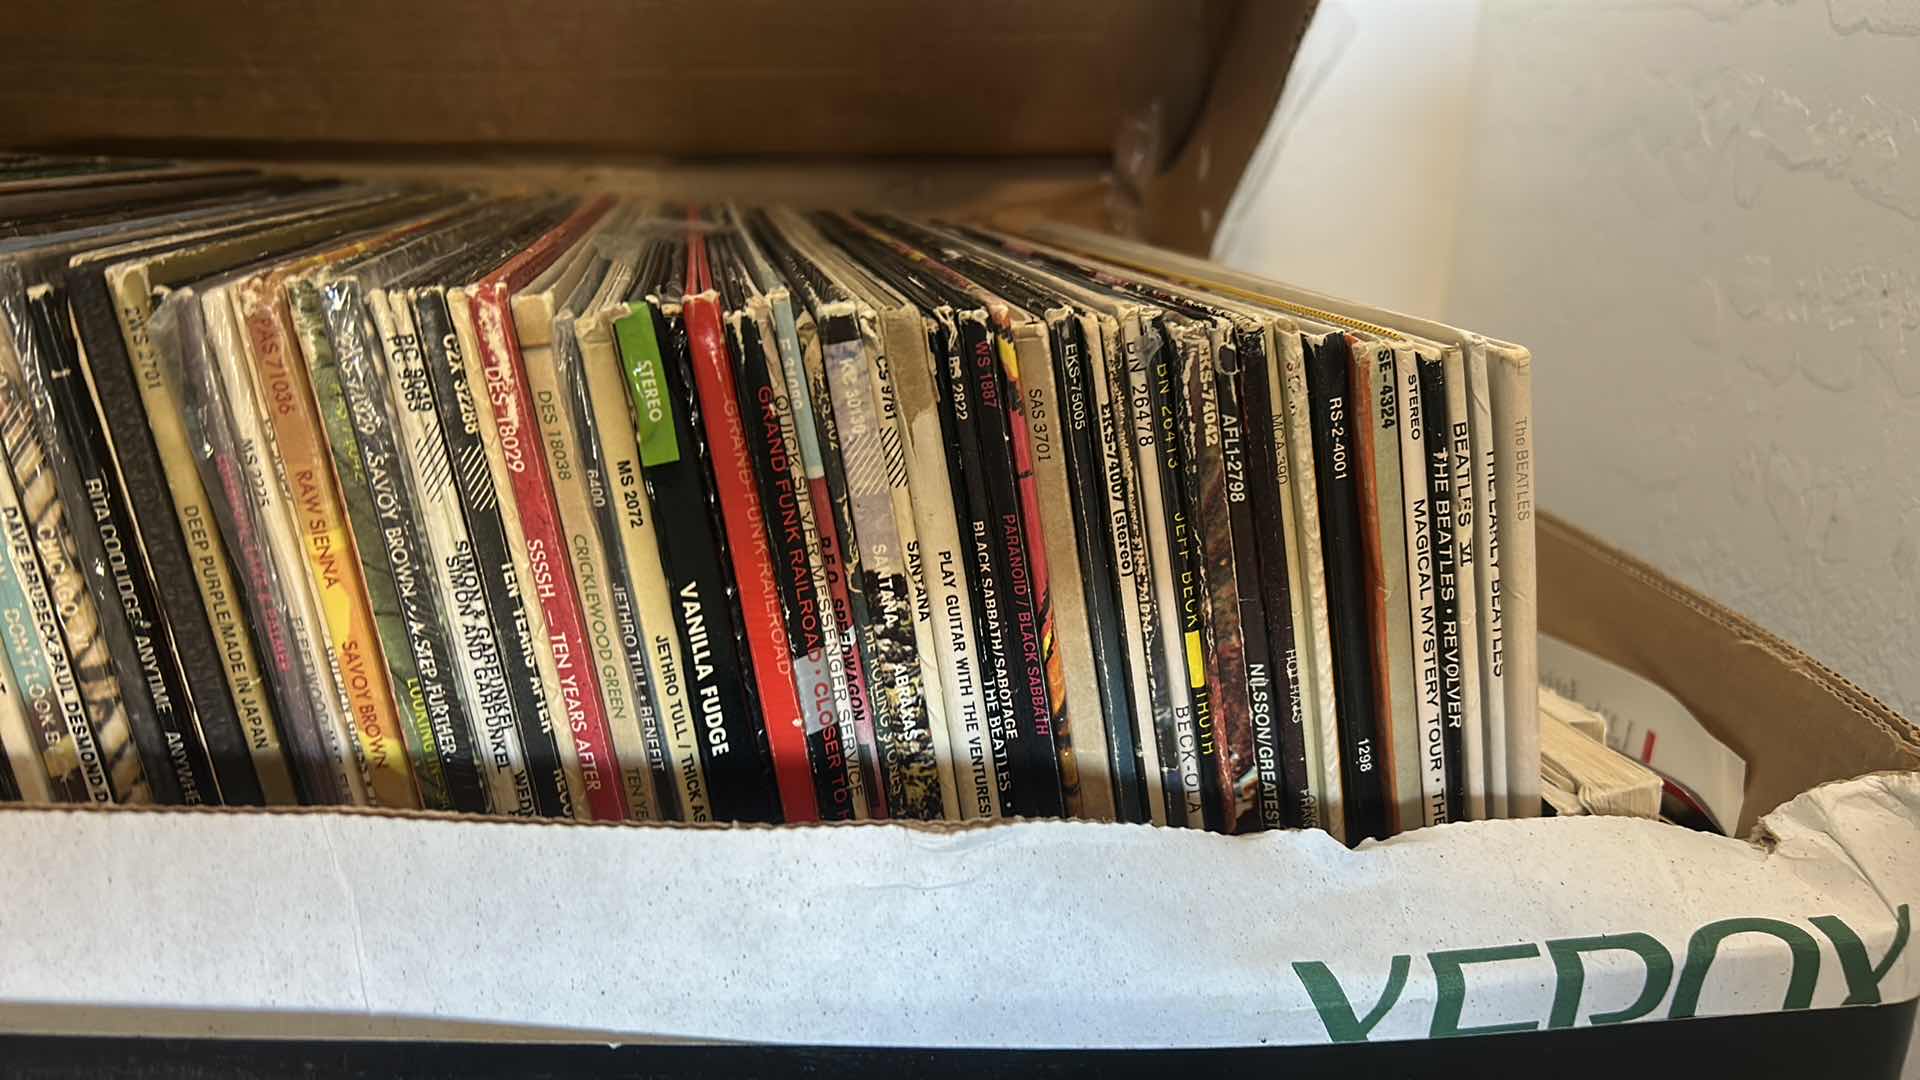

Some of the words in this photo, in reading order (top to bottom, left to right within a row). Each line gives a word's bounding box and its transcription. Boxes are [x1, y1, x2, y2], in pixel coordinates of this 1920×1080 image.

[251, 317, 280, 356] PAS
[974, 340, 993, 368] WS
[263, 358, 295, 417] 71036
[485, 365, 510, 407] DES
[637, 359, 663, 423] STEREO
[875, 355, 890, 381] CS
[979, 373, 999, 409] 1887
[1064, 343, 1087, 431] EKS-75005
[881, 384, 898, 421] 9781
[952, 383, 969, 421] 2822
[1028, 388, 1047, 421] SAS
[1132, 384, 1156, 447] 26478
[1407, 373, 1422, 441] STEREO
[1514, 415, 1528, 447] The
[496, 417, 526, 475] 18029
[535, 390, 559, 426] DES
[547, 428, 574, 482] 18038
[1034, 425, 1052, 463] 3701
[1222, 413, 1247, 504] AFL1-2798
[1328, 396, 1349, 481] RS-2-4001
[295, 469, 322, 516] RAW
[367, 453, 399, 520] SAVOY
[616, 460, 635, 487] MS
[1432, 447, 1450, 494] THE
[1452, 421, 1474, 528] BEATLES
[1515, 449, 1532, 522] BEATLES
[184, 505, 209, 549] DEEP
[624, 489, 645, 530] 2072
[308, 517, 340, 589] SIENNA
[385, 526, 418, 599] BROWN
[938, 550, 958, 590] PLAY
[972, 520, 991, 573] BLACK
[1001, 513, 1028, 598] PARANOID
[1412, 499, 1433, 601] MAGICAL
[1434, 499, 1456, 607] BEATLES
[86, 478, 111, 521] RITA
[135, 634, 173, 714] ANYTIME
[501, 562, 521, 598] TEN
[743, 494, 769, 555] FUNK
[757, 560, 793, 676] RAILROAD
[758, 385, 790, 473] GRAND
[775, 480, 801, 543] FUNK
[788, 548, 823, 665] RAILROAD
[813, 680, 844, 770] CLOSER
[906, 540, 931, 623] SANTANA
[1181, 570, 1199, 629] BECK
[462, 623, 484, 661] AND
[611, 582, 640, 646] JETHRO
[862, 624, 877, 654] THE
[873, 542, 900, 629] SANTANA
[892, 662, 917, 742] ABRAXAS
[945, 594, 967, 653] GUITAR
[1016, 610, 1039, 664] BLACK
[3, 506, 30, 557] DAVE
[65, 702, 103, 788] DESMOND
[415, 638, 439, 680] STEP
[549, 630, 574, 670] TEN
[573, 533, 613, 665] CRICKLEWOOD
[601, 663, 628, 720] GREEN
[625, 767, 643, 798] TEN
[625, 645, 648, 690] TULL
[680, 580, 715, 681] VANILLA
[699, 685, 731, 758] FUDGE
[832, 599, 866, 722] SPEEDWAGON
[955, 657, 974, 698] WITH
[1420, 604, 1441, 707] MYSTERY
[1441, 620, 1463, 729] REVOLVER
[235, 671, 252, 697] IN
[341, 639, 372, 703] SAVOY
[359, 704, 390, 770] BROWN
[559, 674, 589, 732] YEARS
[810, 566, 848, 702] MESSENGER
[837, 707, 865, 797] SERVICE
[868, 657, 893, 728] ROLLING
[983, 678, 1001, 711] THE
[1026, 665, 1050, 737] SABBATH
[240, 698, 269, 751] JAPAN
[407, 675, 437, 753] LOOKING
[426, 682, 457, 758] FURTHER
[638, 704, 666, 772] BENEFIT
[655, 634, 680, 697] JETHRO
[669, 698, 690, 743] TULL
[680, 752, 704, 807] THICK
[962, 701, 980, 732] THE
[1427, 714, 1444, 773] TOUR
[574, 736, 602, 793] AFTER
[989, 714, 1012, 793] BEATLES
[1174, 705, 1202, 815] BECK-OLA
[1357, 737, 1373, 773] 1298
